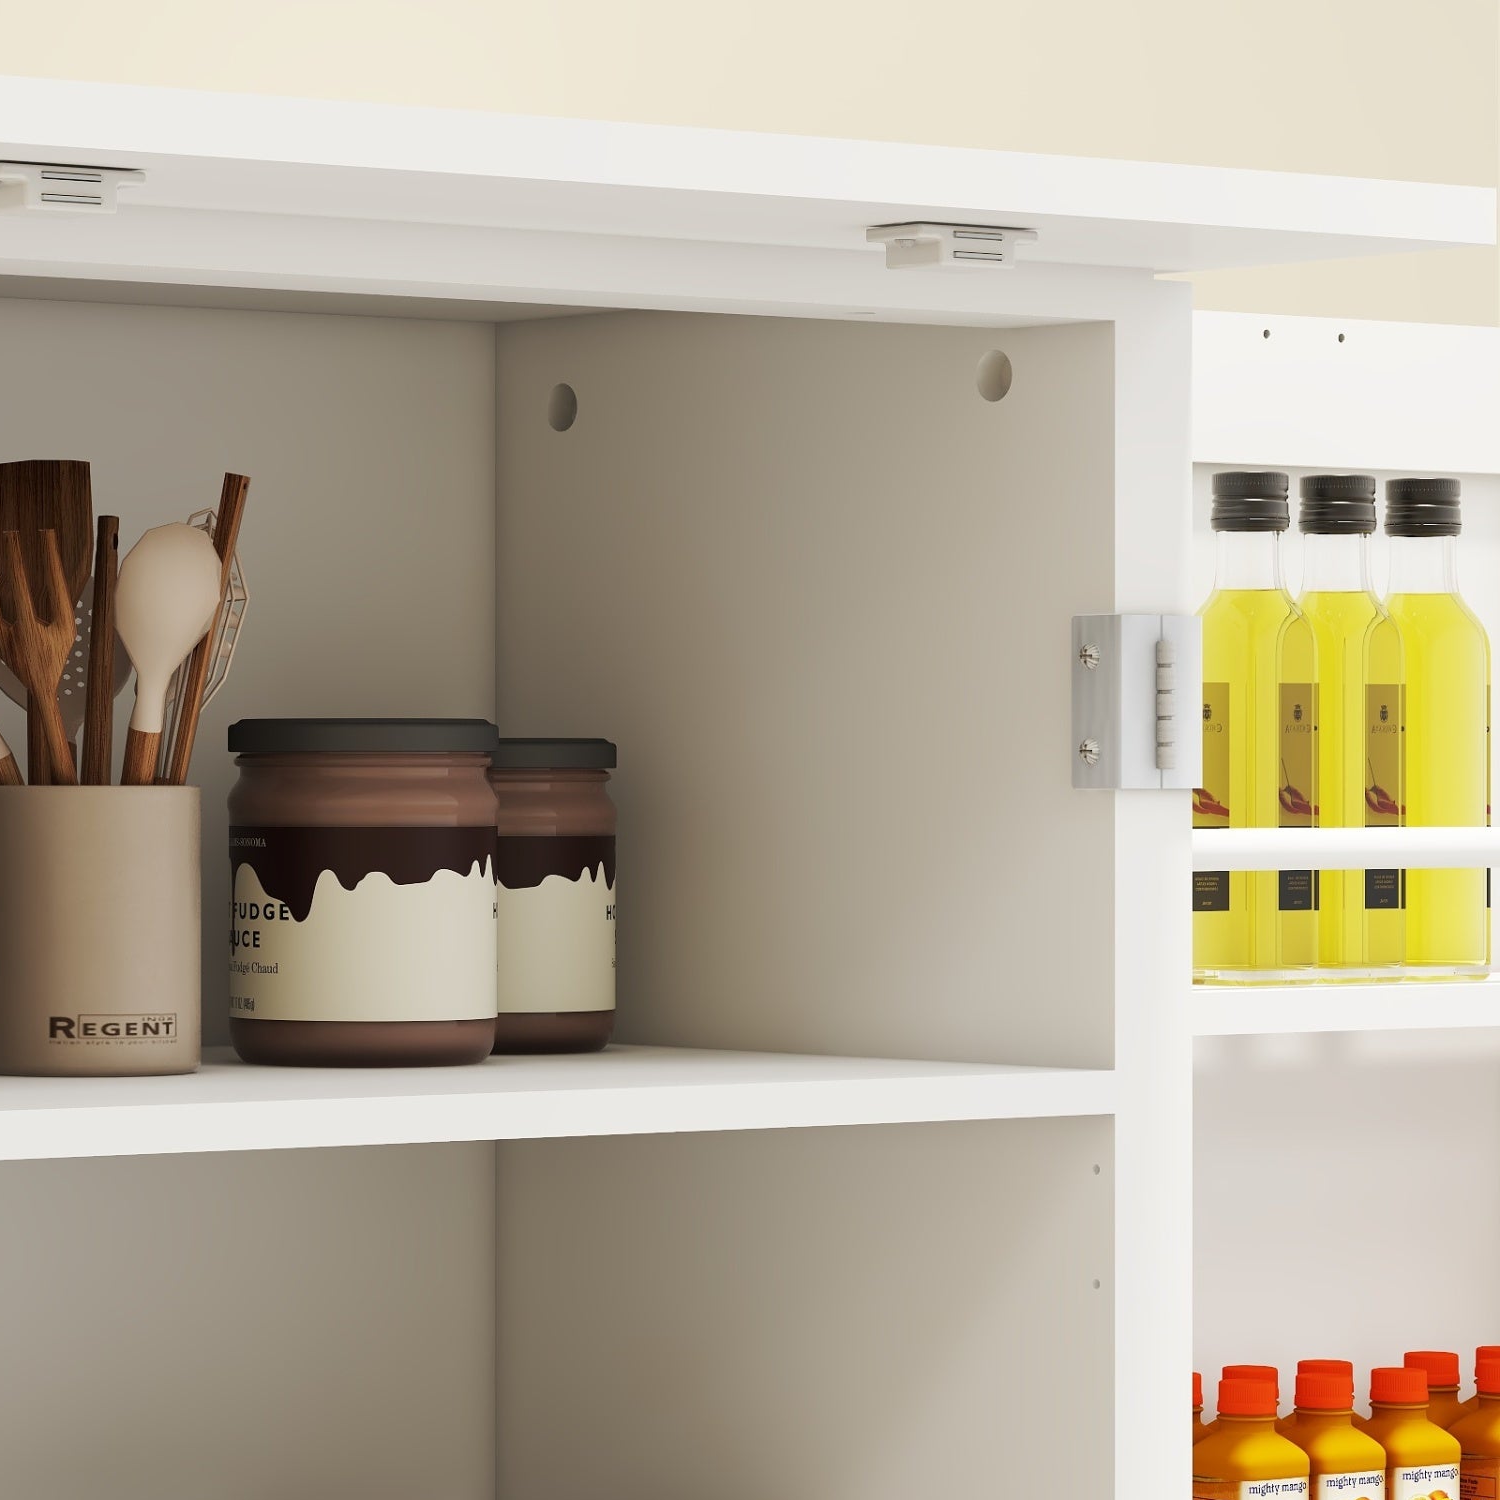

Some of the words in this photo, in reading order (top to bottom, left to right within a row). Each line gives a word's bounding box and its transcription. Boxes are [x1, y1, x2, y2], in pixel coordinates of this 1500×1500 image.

[233, 902, 290, 921] FUDGE
[251, 962, 279, 975] Chaud
[48, 1016, 174, 1039] REGENT
[1326, 1475, 1356, 1489] mighty
[1402, 1468, 1433, 1482] mighty
[1248, 1482, 1280, 1496] mighty
